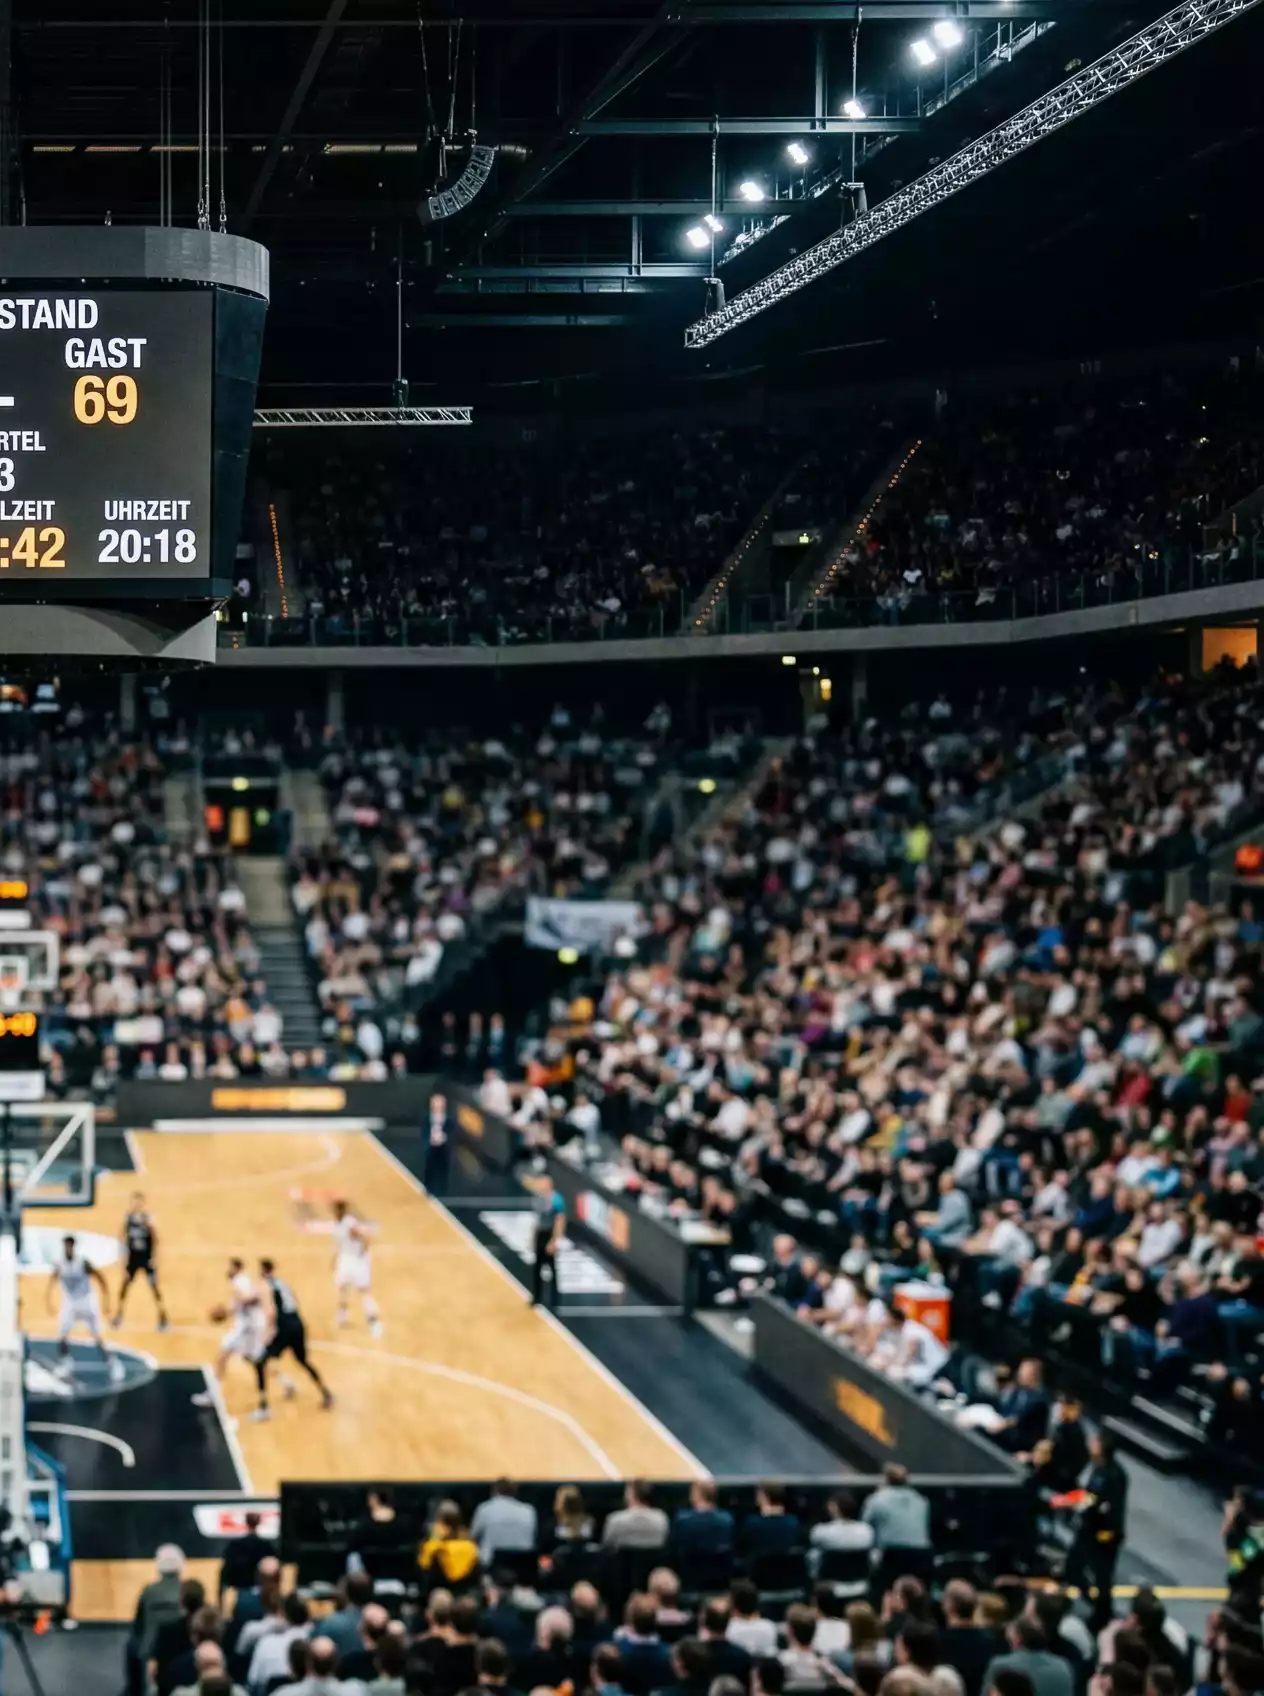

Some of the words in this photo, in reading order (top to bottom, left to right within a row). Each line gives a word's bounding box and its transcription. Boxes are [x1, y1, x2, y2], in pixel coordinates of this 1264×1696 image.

[65, 338, 146, 368] GAST
[74, 375, 137, 424] 69
[105, 501, 190, 520] UHRZEIT
[99, 529, 196, 563] 20:18
